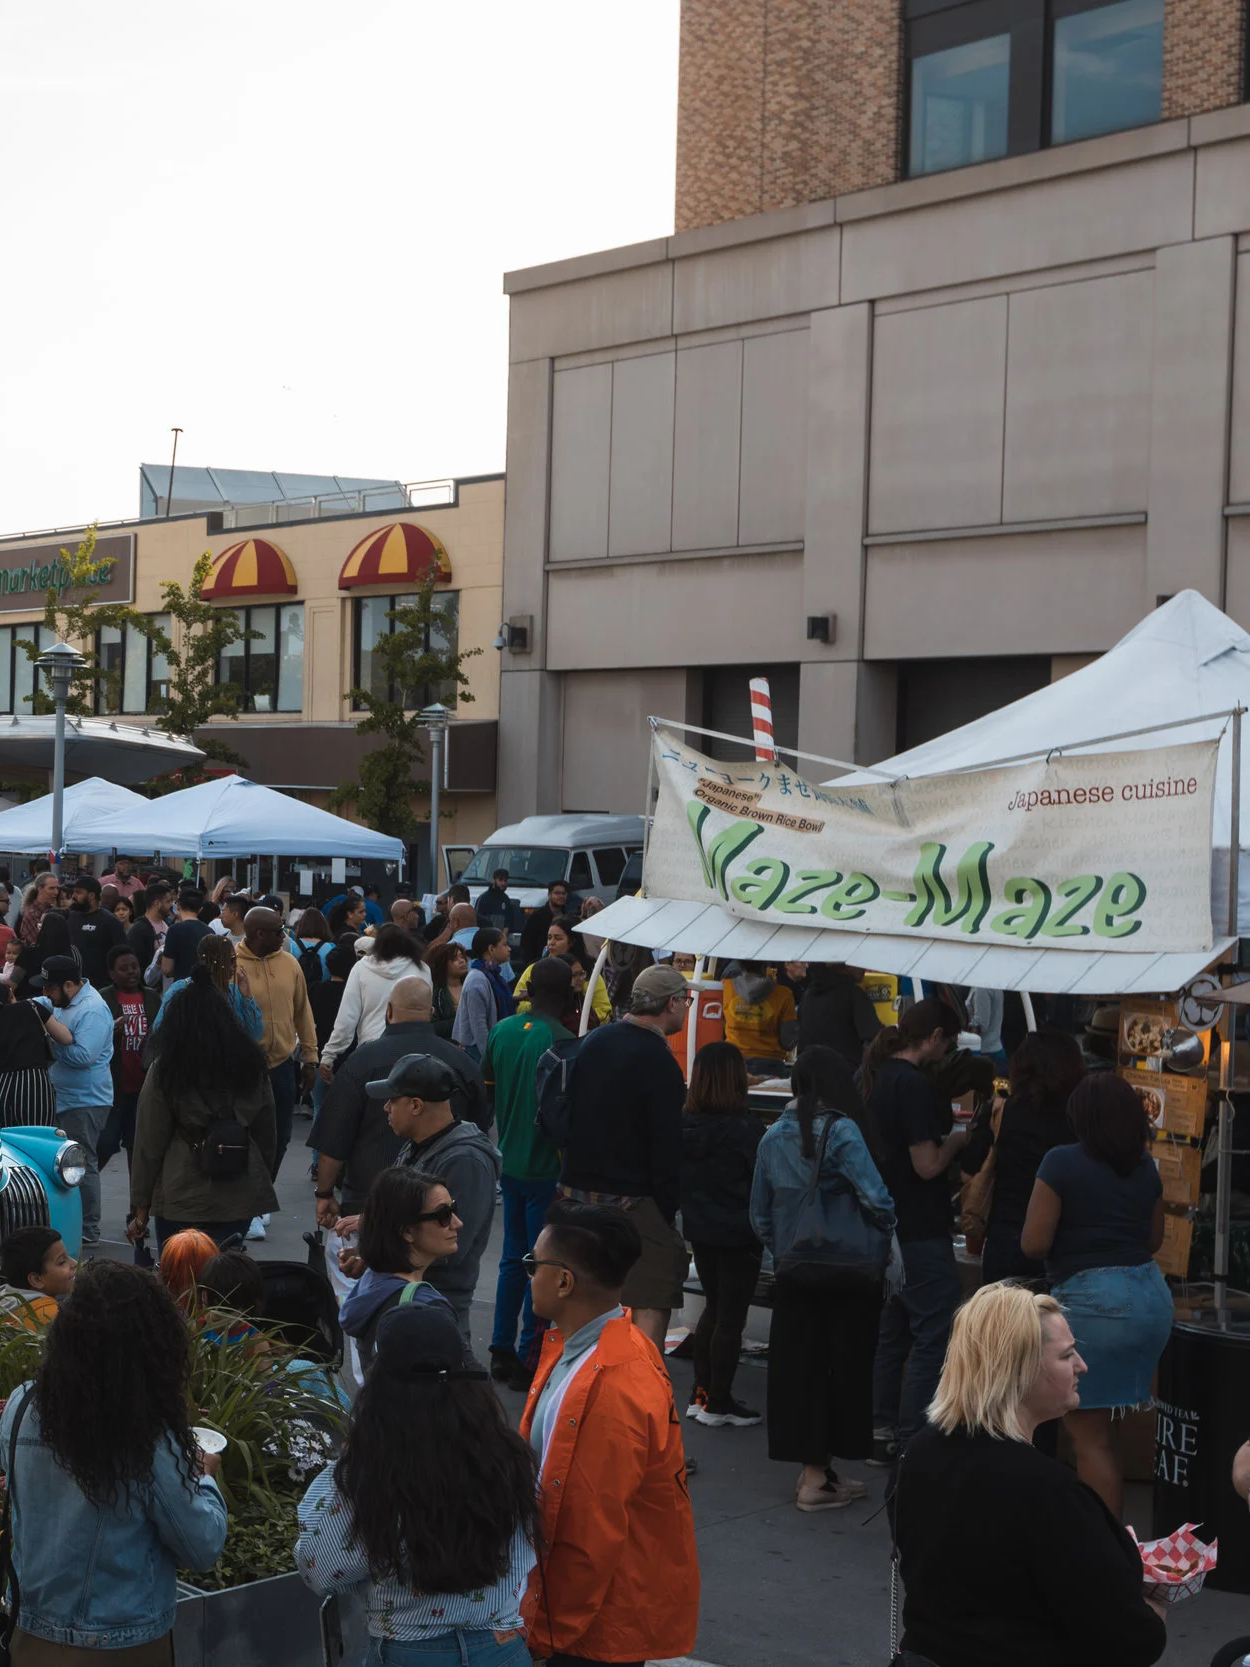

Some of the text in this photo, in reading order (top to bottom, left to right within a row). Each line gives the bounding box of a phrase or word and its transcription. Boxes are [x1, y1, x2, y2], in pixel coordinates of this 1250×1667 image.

[694, 789, 738, 812] Organic
[738, 805, 773, 823] Brown
[775, 814, 796, 827] Rice
[1007, 784, 1114, 811] Japanese
[1121, 776, 1198, 801] cuisine
[686, 800, 1147, 939] Maze-Maze
[1174, 1406, 1189, 1420] TEA
